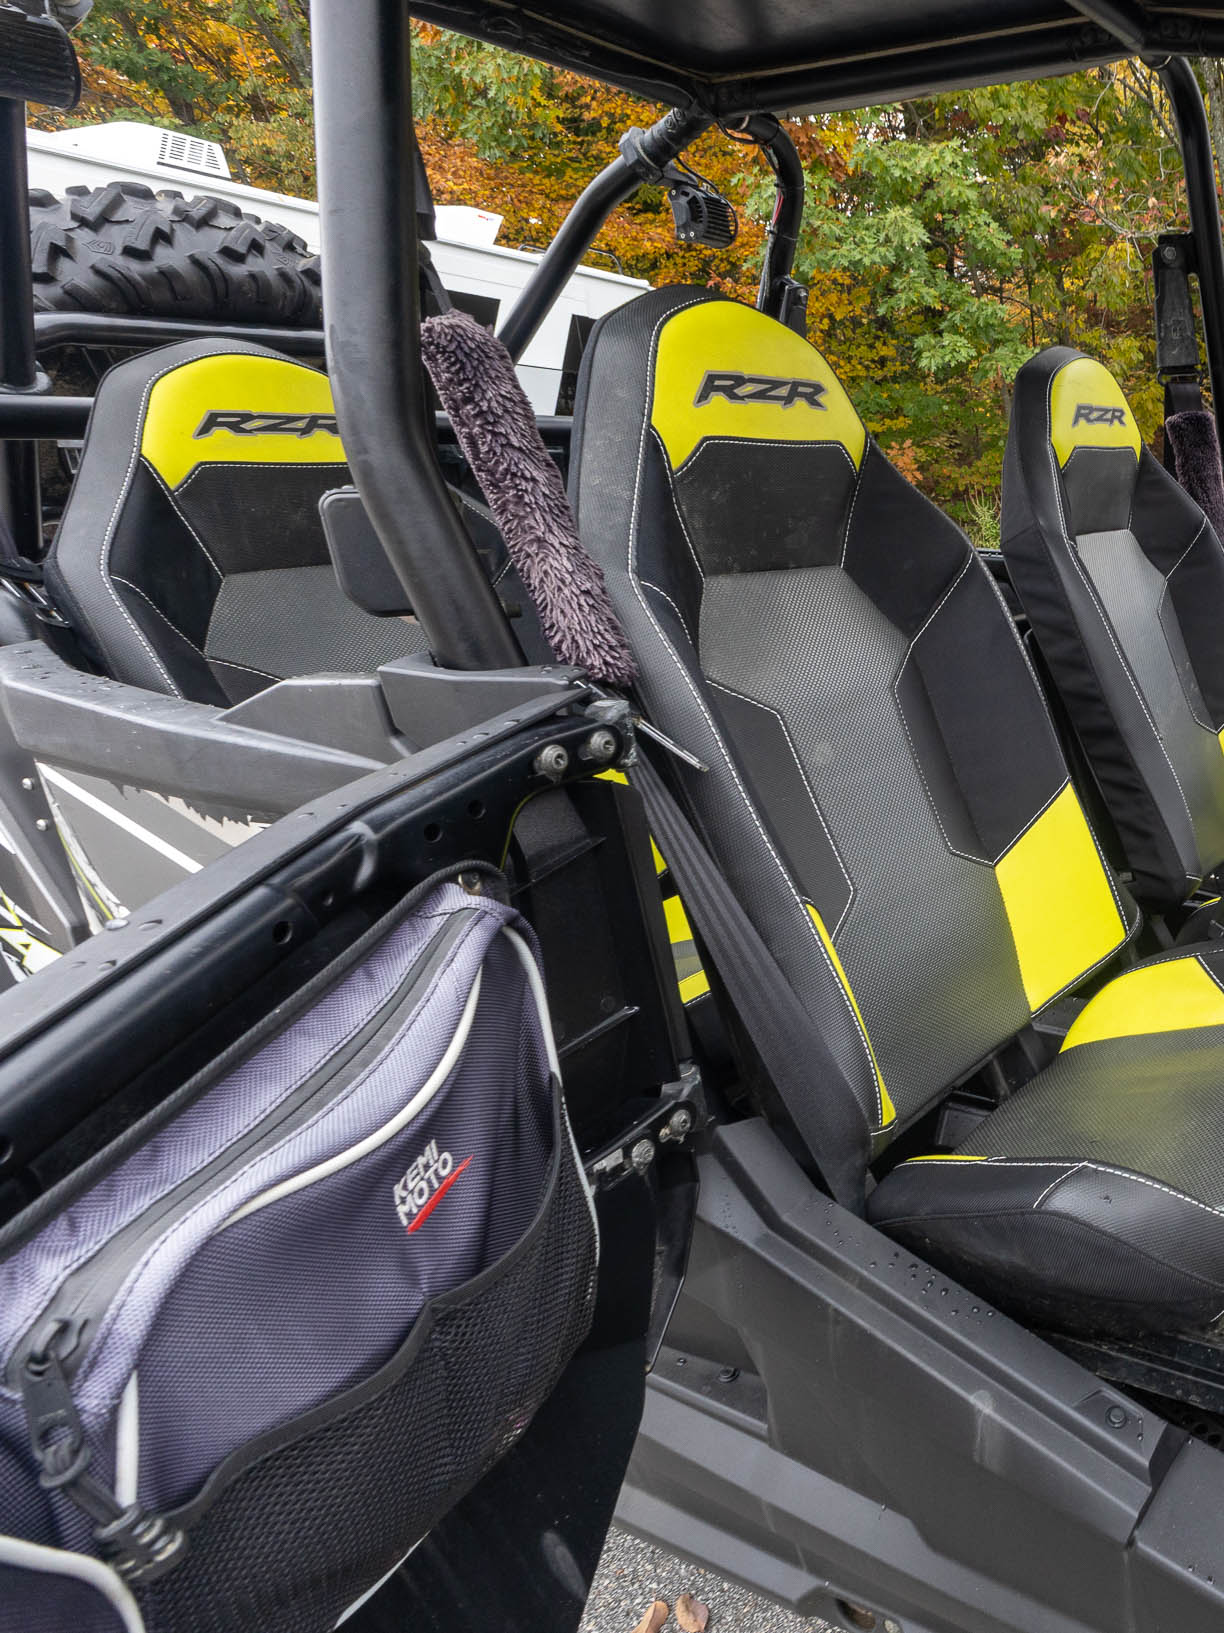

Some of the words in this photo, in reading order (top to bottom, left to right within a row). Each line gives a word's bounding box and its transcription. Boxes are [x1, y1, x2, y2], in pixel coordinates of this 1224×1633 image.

[693, 370, 827, 411] RZR
[193, 410, 341, 439] RZR
[1072, 403, 1126, 428] RZR
[393, 1139, 439, 1205] KEMI
[396, 1151, 453, 1226] MOTO
